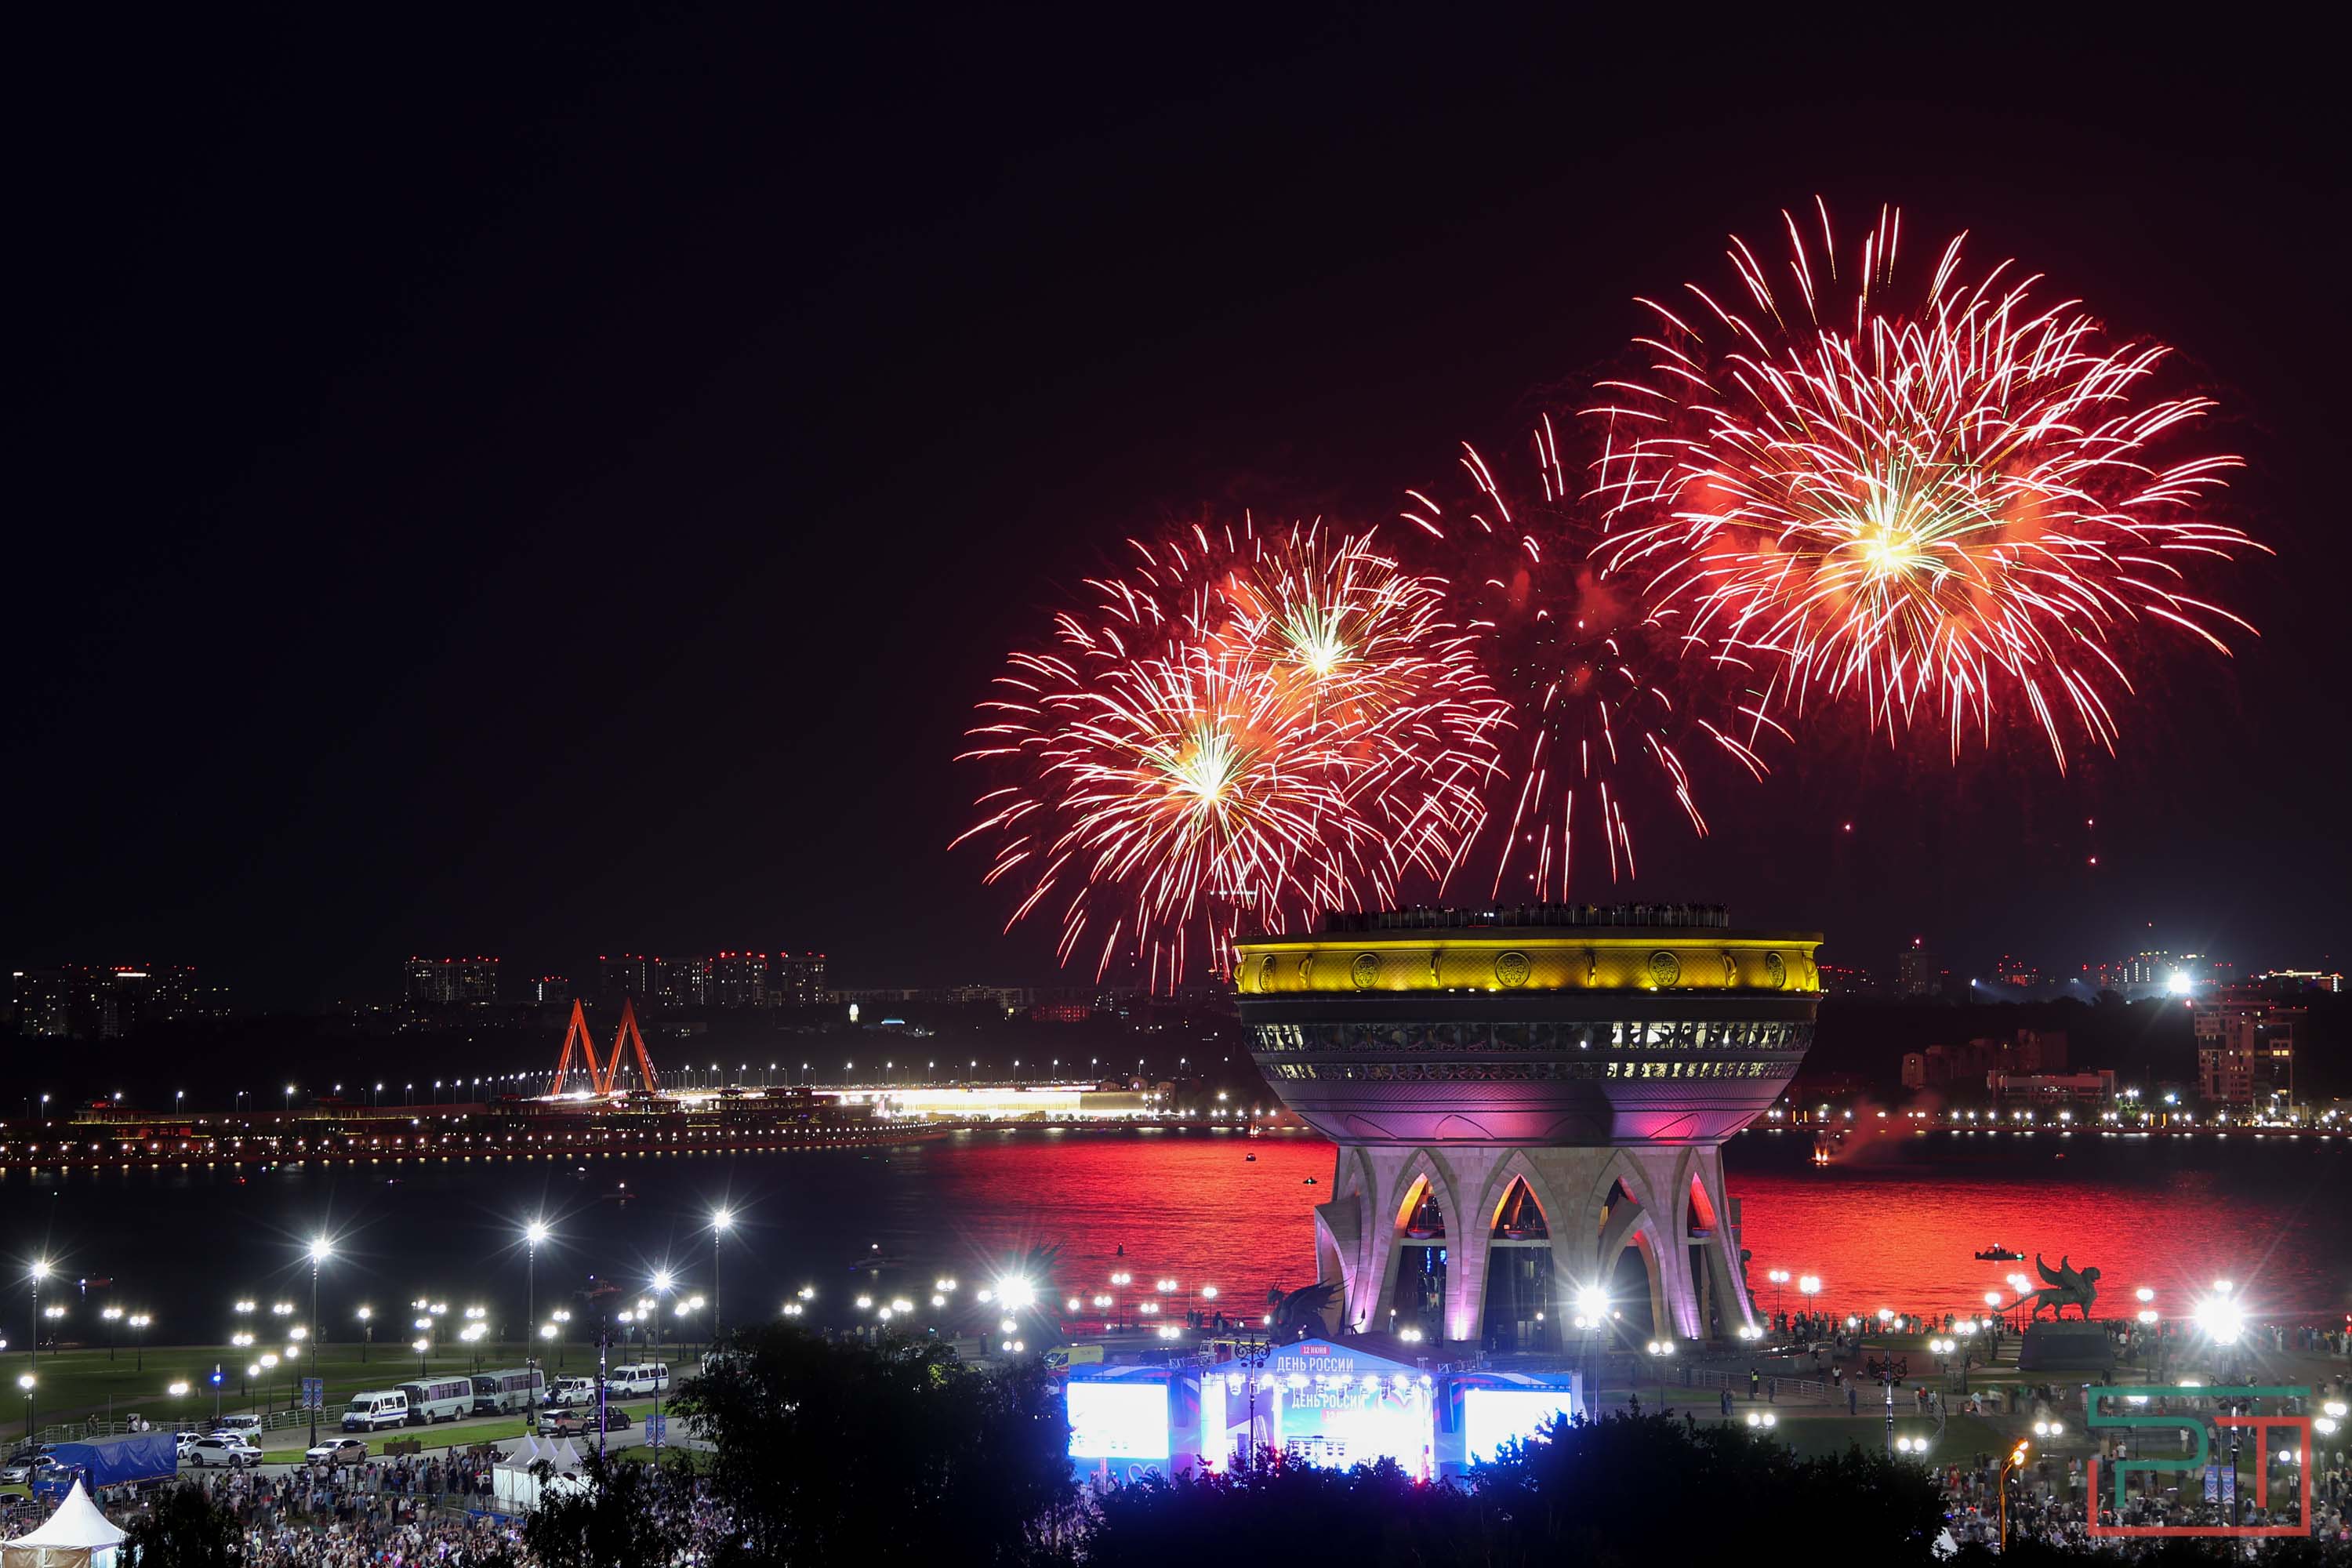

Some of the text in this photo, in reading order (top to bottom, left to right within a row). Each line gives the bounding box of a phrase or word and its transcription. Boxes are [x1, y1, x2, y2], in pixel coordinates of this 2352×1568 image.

[1311, 1346, 1327, 1355] ИЮНЯ
[1276, 1356, 1354, 1373] ДЕНЬ РОССИИ
[1292, 1393, 1319, 1409] ДЕНЬ
